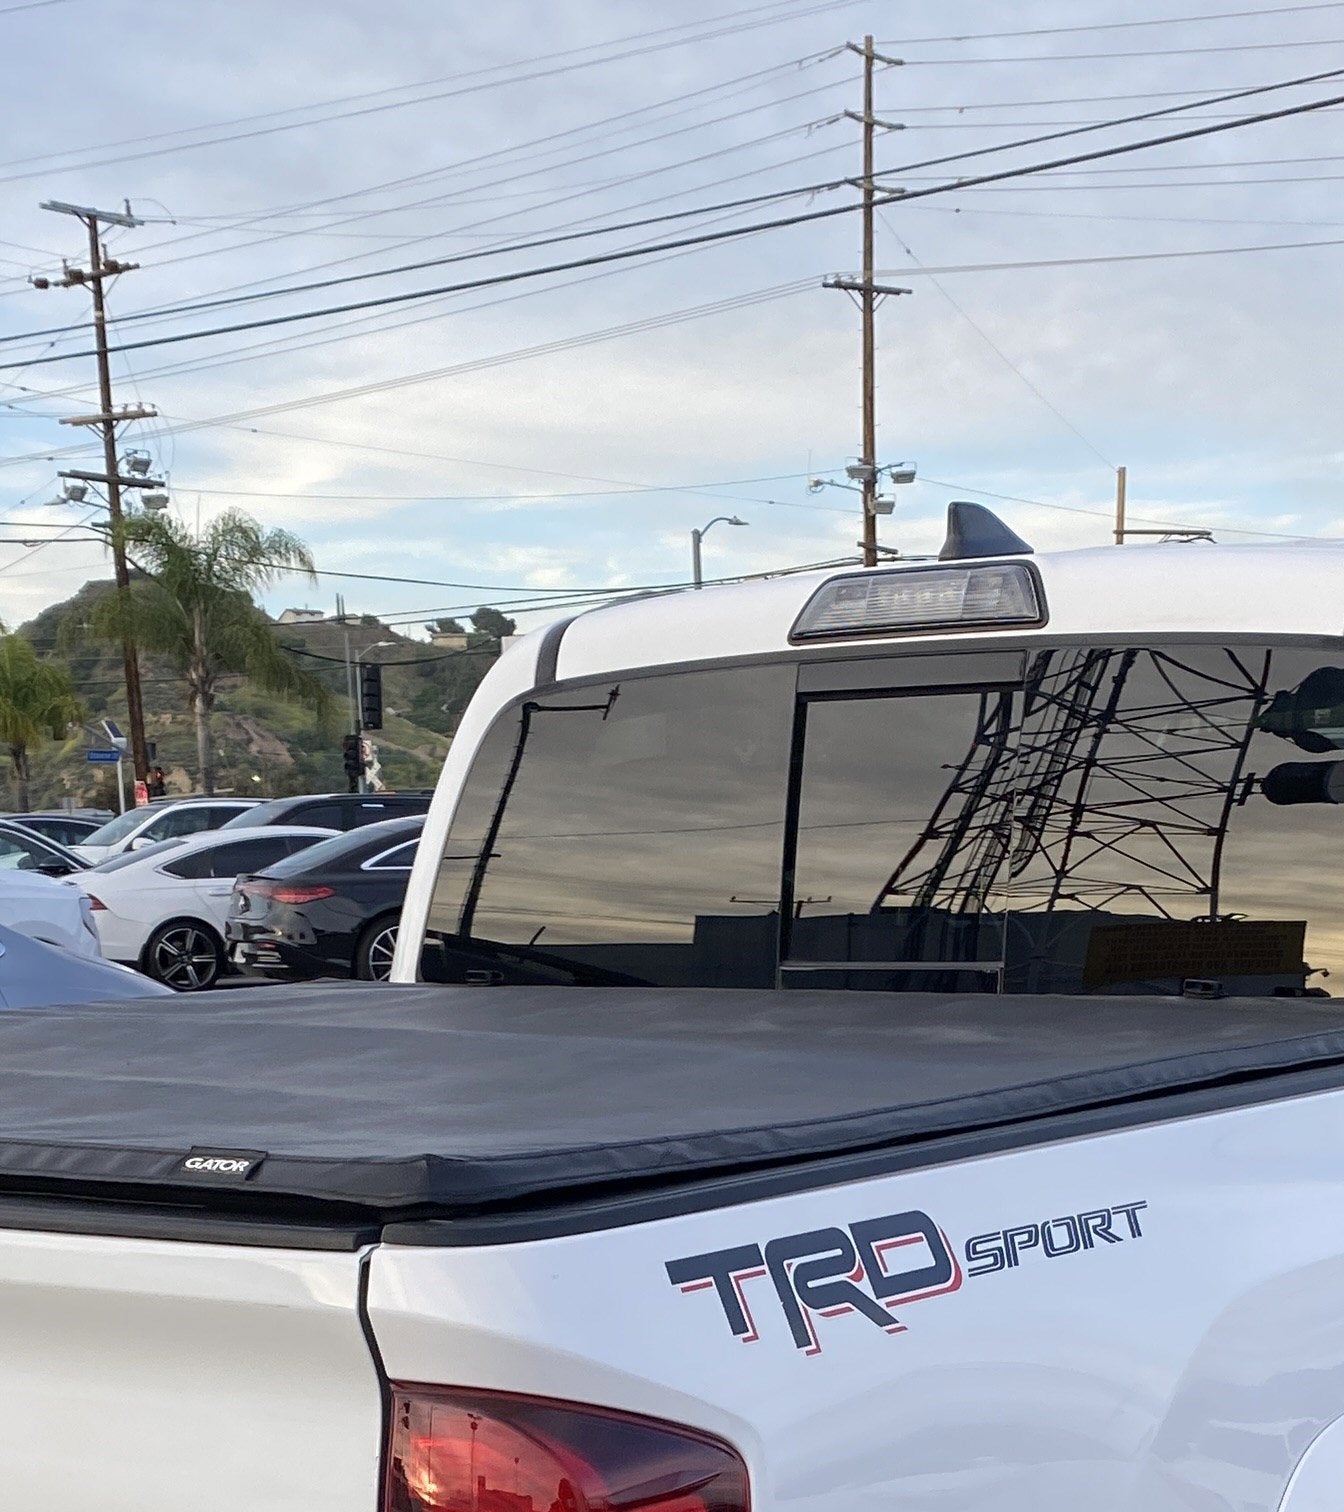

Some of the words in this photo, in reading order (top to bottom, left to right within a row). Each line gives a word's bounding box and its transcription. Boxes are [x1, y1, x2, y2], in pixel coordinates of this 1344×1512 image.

[184, 1157, 250, 1172] GATOR
[664, 1209, 963, 1356] TRD
[964, 1200, 1149, 1278] SPORT
